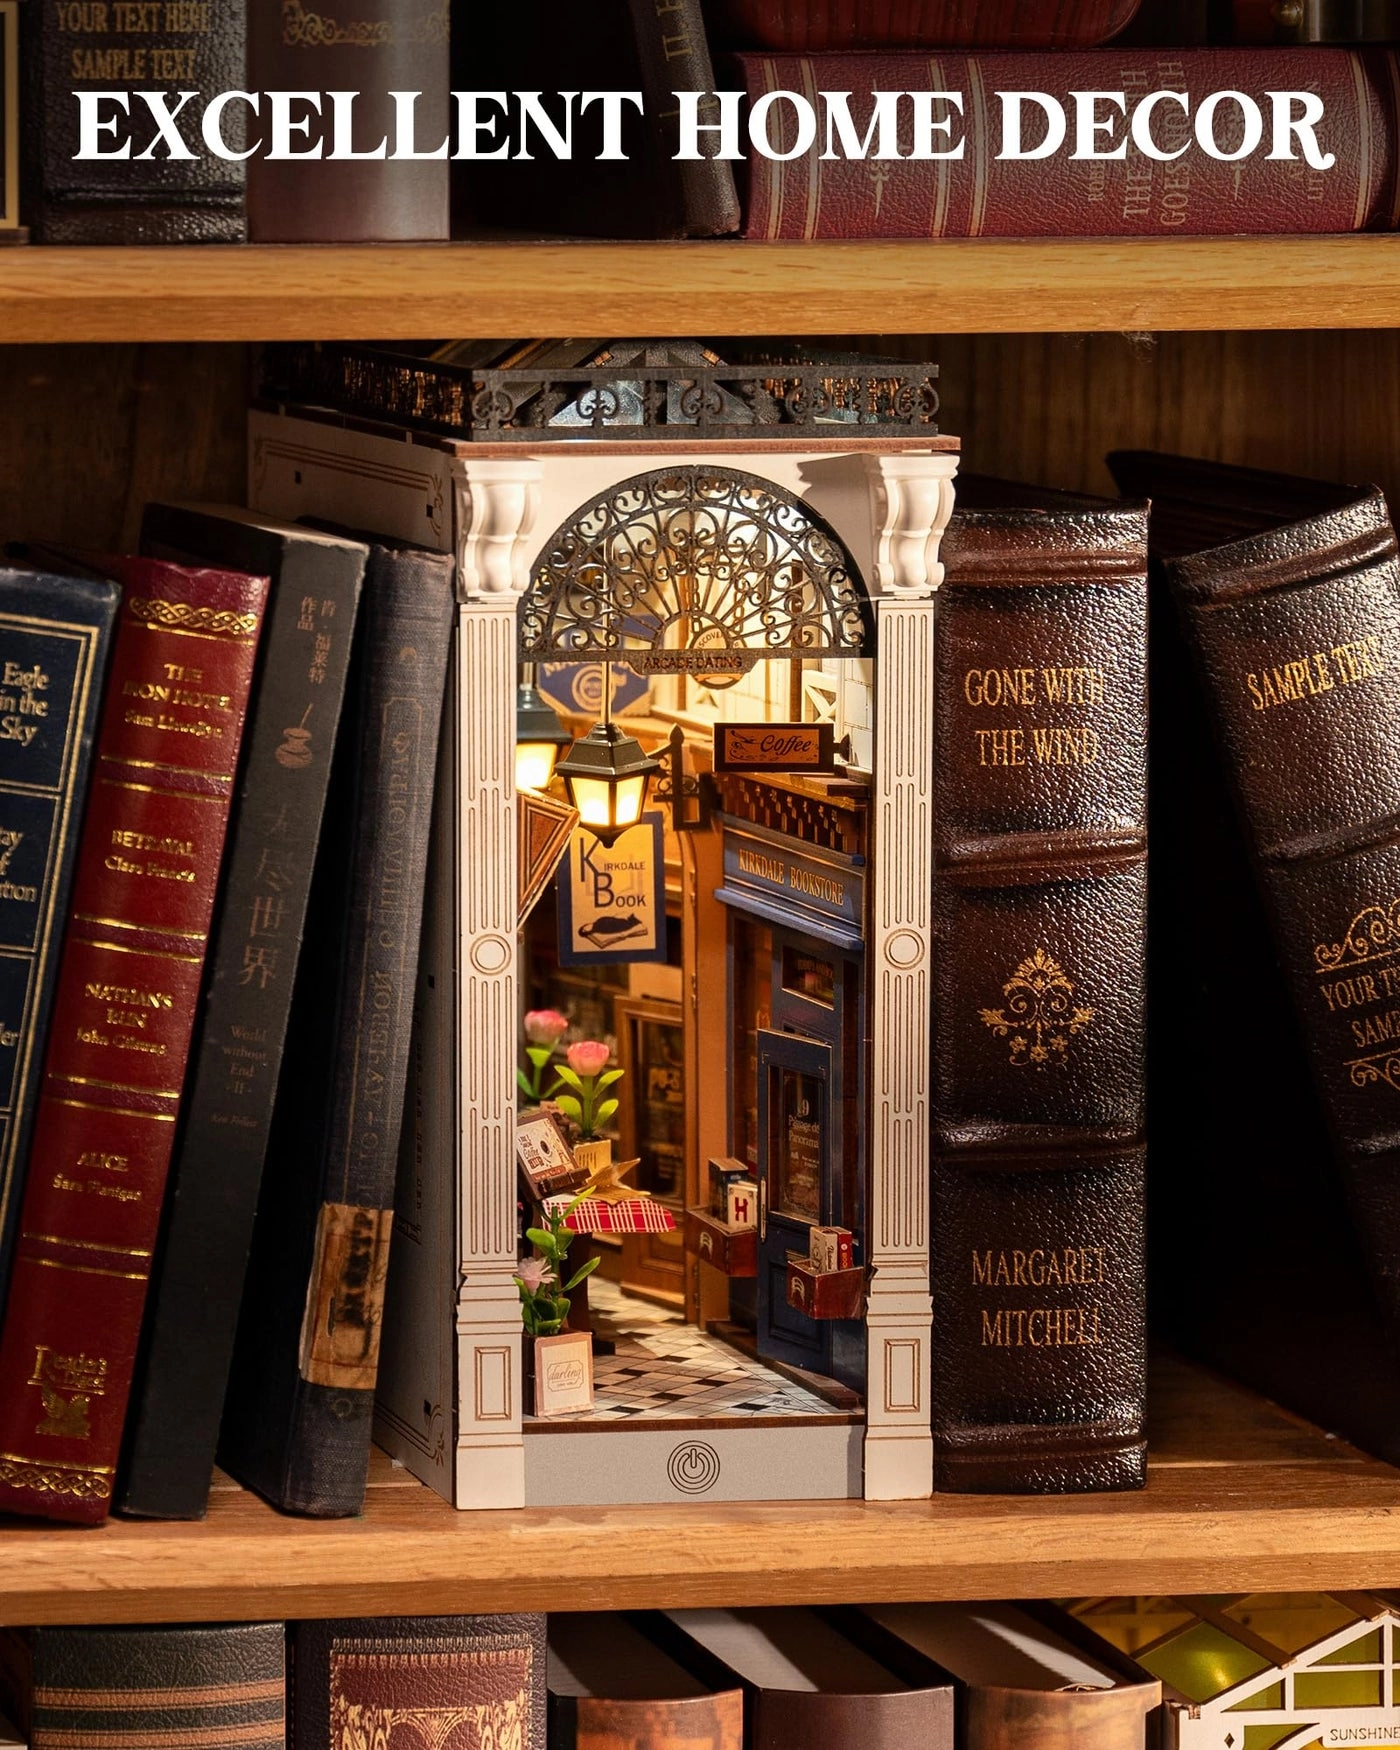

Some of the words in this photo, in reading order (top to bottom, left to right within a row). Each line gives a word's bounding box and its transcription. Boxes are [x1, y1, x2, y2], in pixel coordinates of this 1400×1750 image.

[55, 3, 108, 33] YOUR
[112, 3, 162, 32] TEXT
[71, 48, 147, 80] SAMPLE
[150, 48, 196, 80] TEXT
[297, 596, 318, 632] 作品
[2, 661, 49, 692] Eagle
[643, 656, 693, 671] ARCADE
[697, 656, 743, 670] DATING
[1247, 651, 1332, 711] SAMPLE
[1332, 635, 1384, 685] TEXT
[964, 669, 1036, 707] GONE
[1042, 667, 1105, 705] WITH
[19, 692, 49, 718] the
[0, 715, 39, 747] Sky
[759, 730, 812, 757] Coffee
[975, 729, 1025, 766] THE
[1033, 727, 1099, 766] WIND
[593, 871, 647, 908] BOOK
[737, 847, 785, 885] KIRKDALE
[789, 865, 845, 907] BOOKSTORE
[1319, 973, 1376, 1013] YOUR
[971, 1248, 1107, 1286] MARGARET
[1329, 1726, 1400, 1742] SUNSHINE
